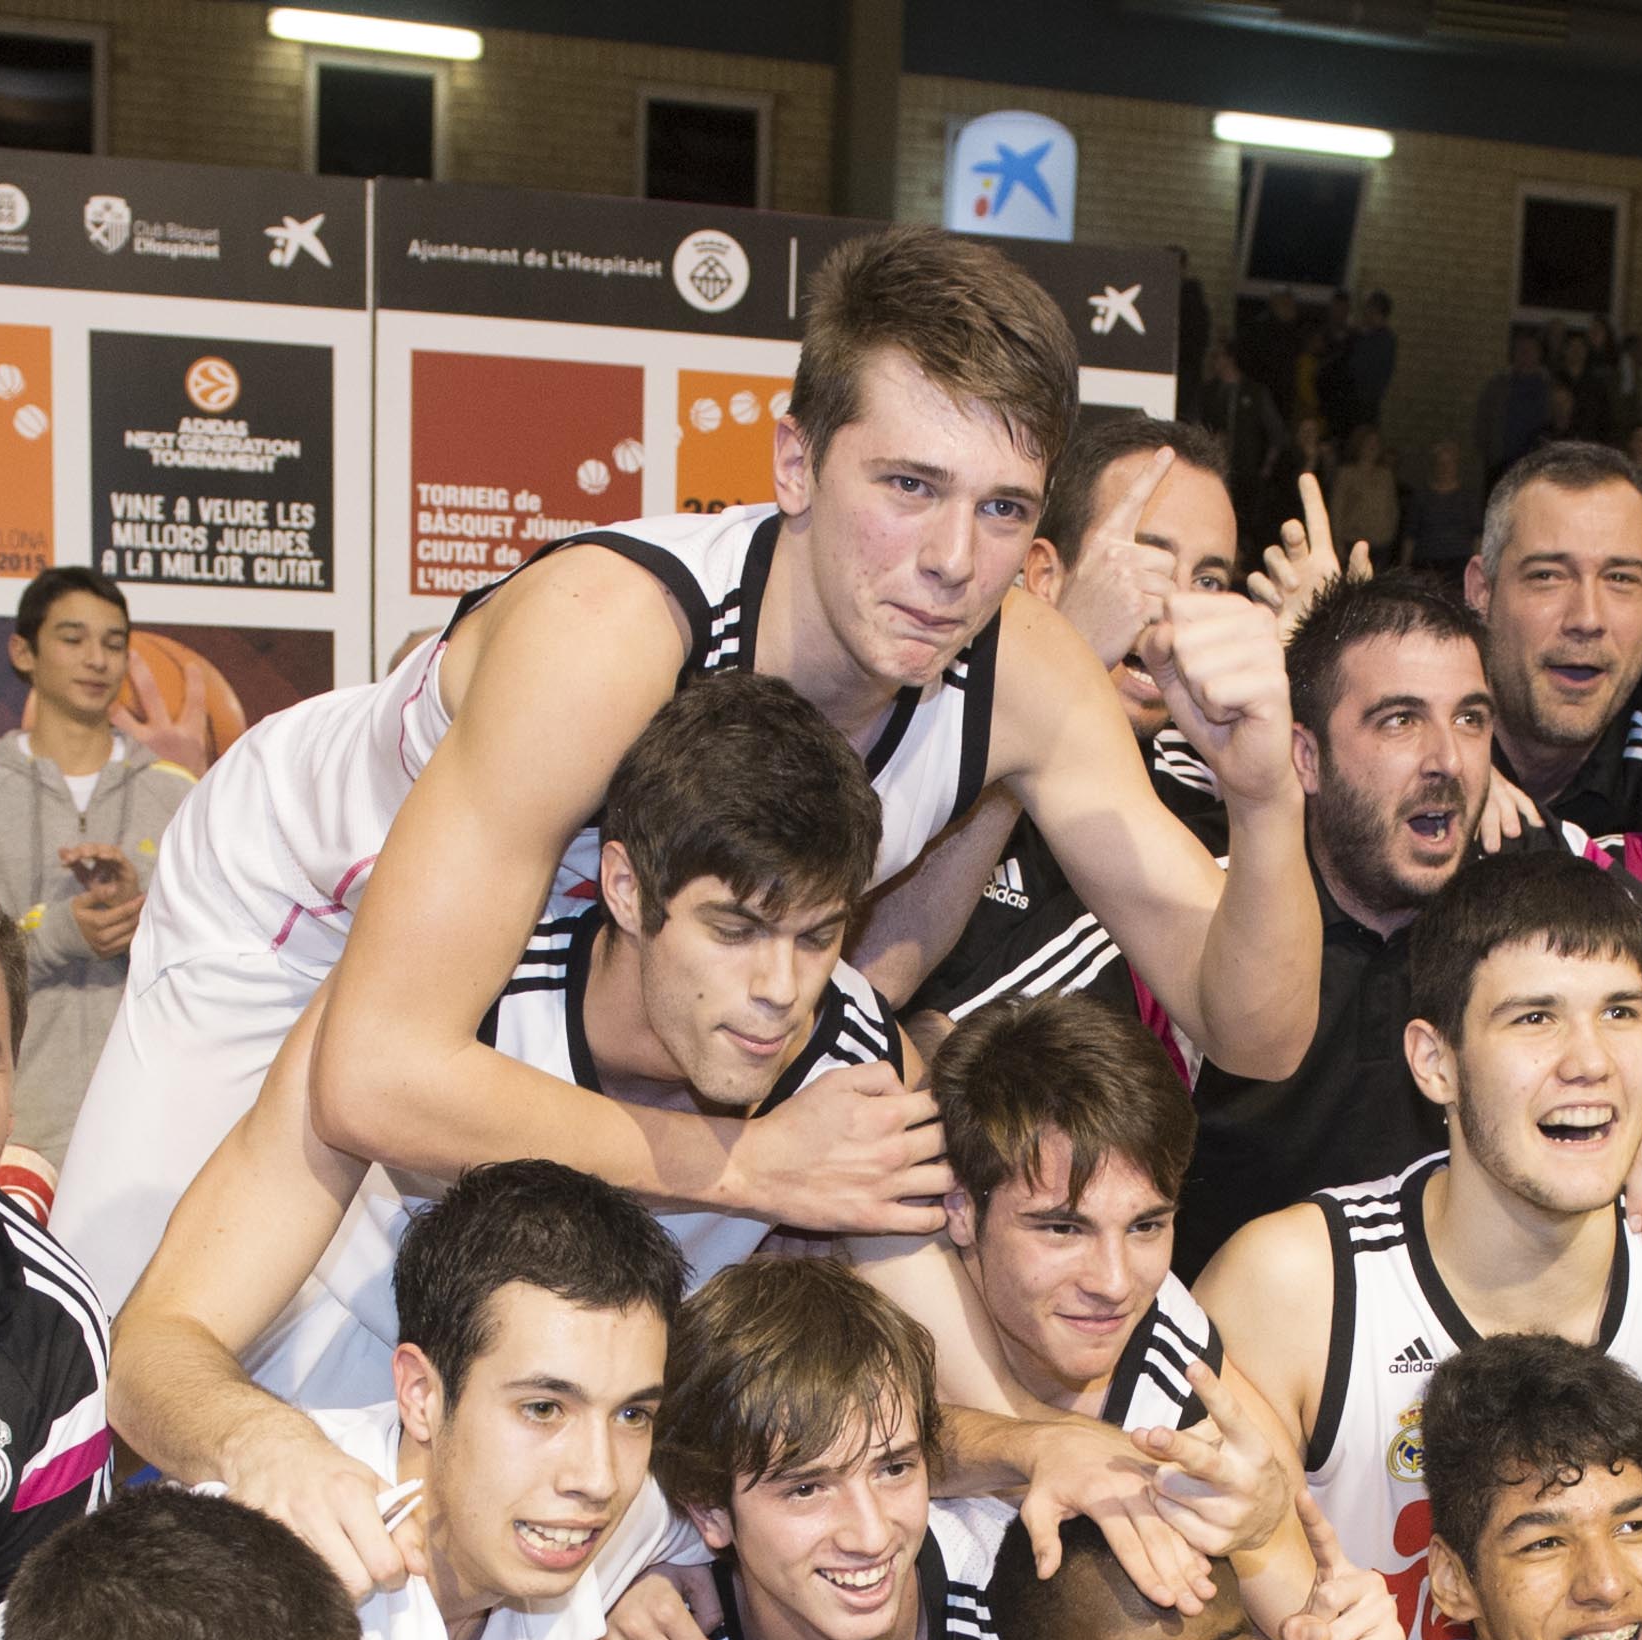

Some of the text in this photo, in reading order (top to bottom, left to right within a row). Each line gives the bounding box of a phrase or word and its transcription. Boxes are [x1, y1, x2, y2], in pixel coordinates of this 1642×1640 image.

[408, 238, 662, 278] Ajuntament de L'Hospitalet
[179, 417, 248, 437] ADIDAS
[124, 429, 301, 458] NEXT GENERATION
[149, 449, 276, 473] TOURNAMENT
[110, 492, 316, 530] VINE A VEURE LES
[417, 483, 541, 512] TORNEIG de
[112, 522, 207, 551] MILLORS
[417, 507, 596, 541] BÀSQUET JÚNIO
[102, 549, 117, 576] A
[125, 551, 153, 578] LA
[161, 553, 245, 582] MILLOR
[417, 540, 521, 567] CIUTAT de
[983, 881, 1029, 910] didas
